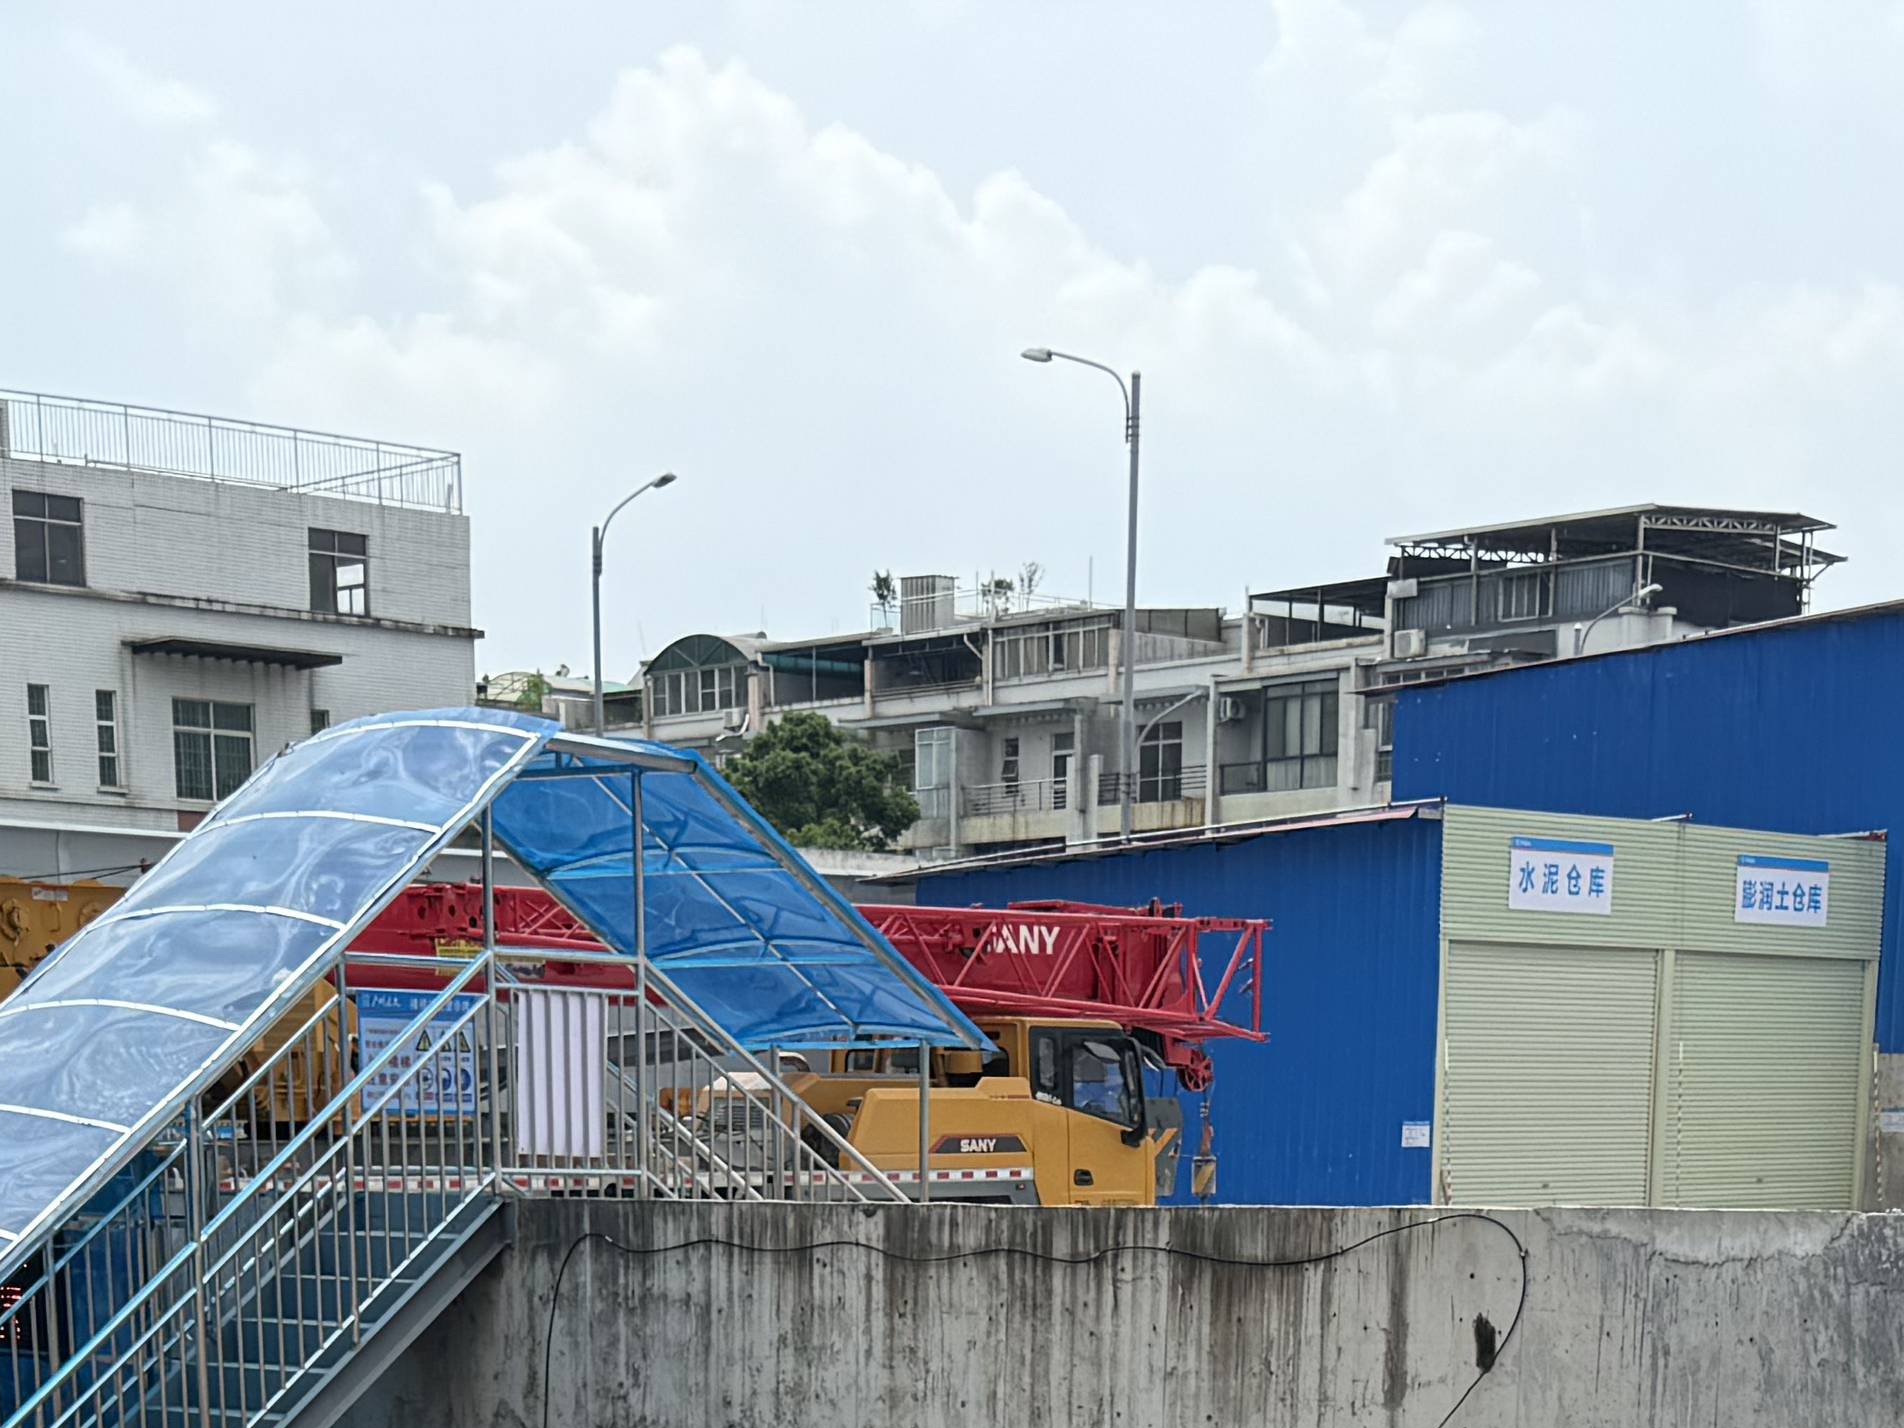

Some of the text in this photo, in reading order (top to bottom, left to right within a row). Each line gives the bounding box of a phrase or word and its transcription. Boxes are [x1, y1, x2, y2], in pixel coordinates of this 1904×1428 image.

[1518, 861, 1606, 899] 水泥仓库
[1741, 879, 1823, 914] 膨润土仓库
[959, 1139, 997, 1153] SANY
